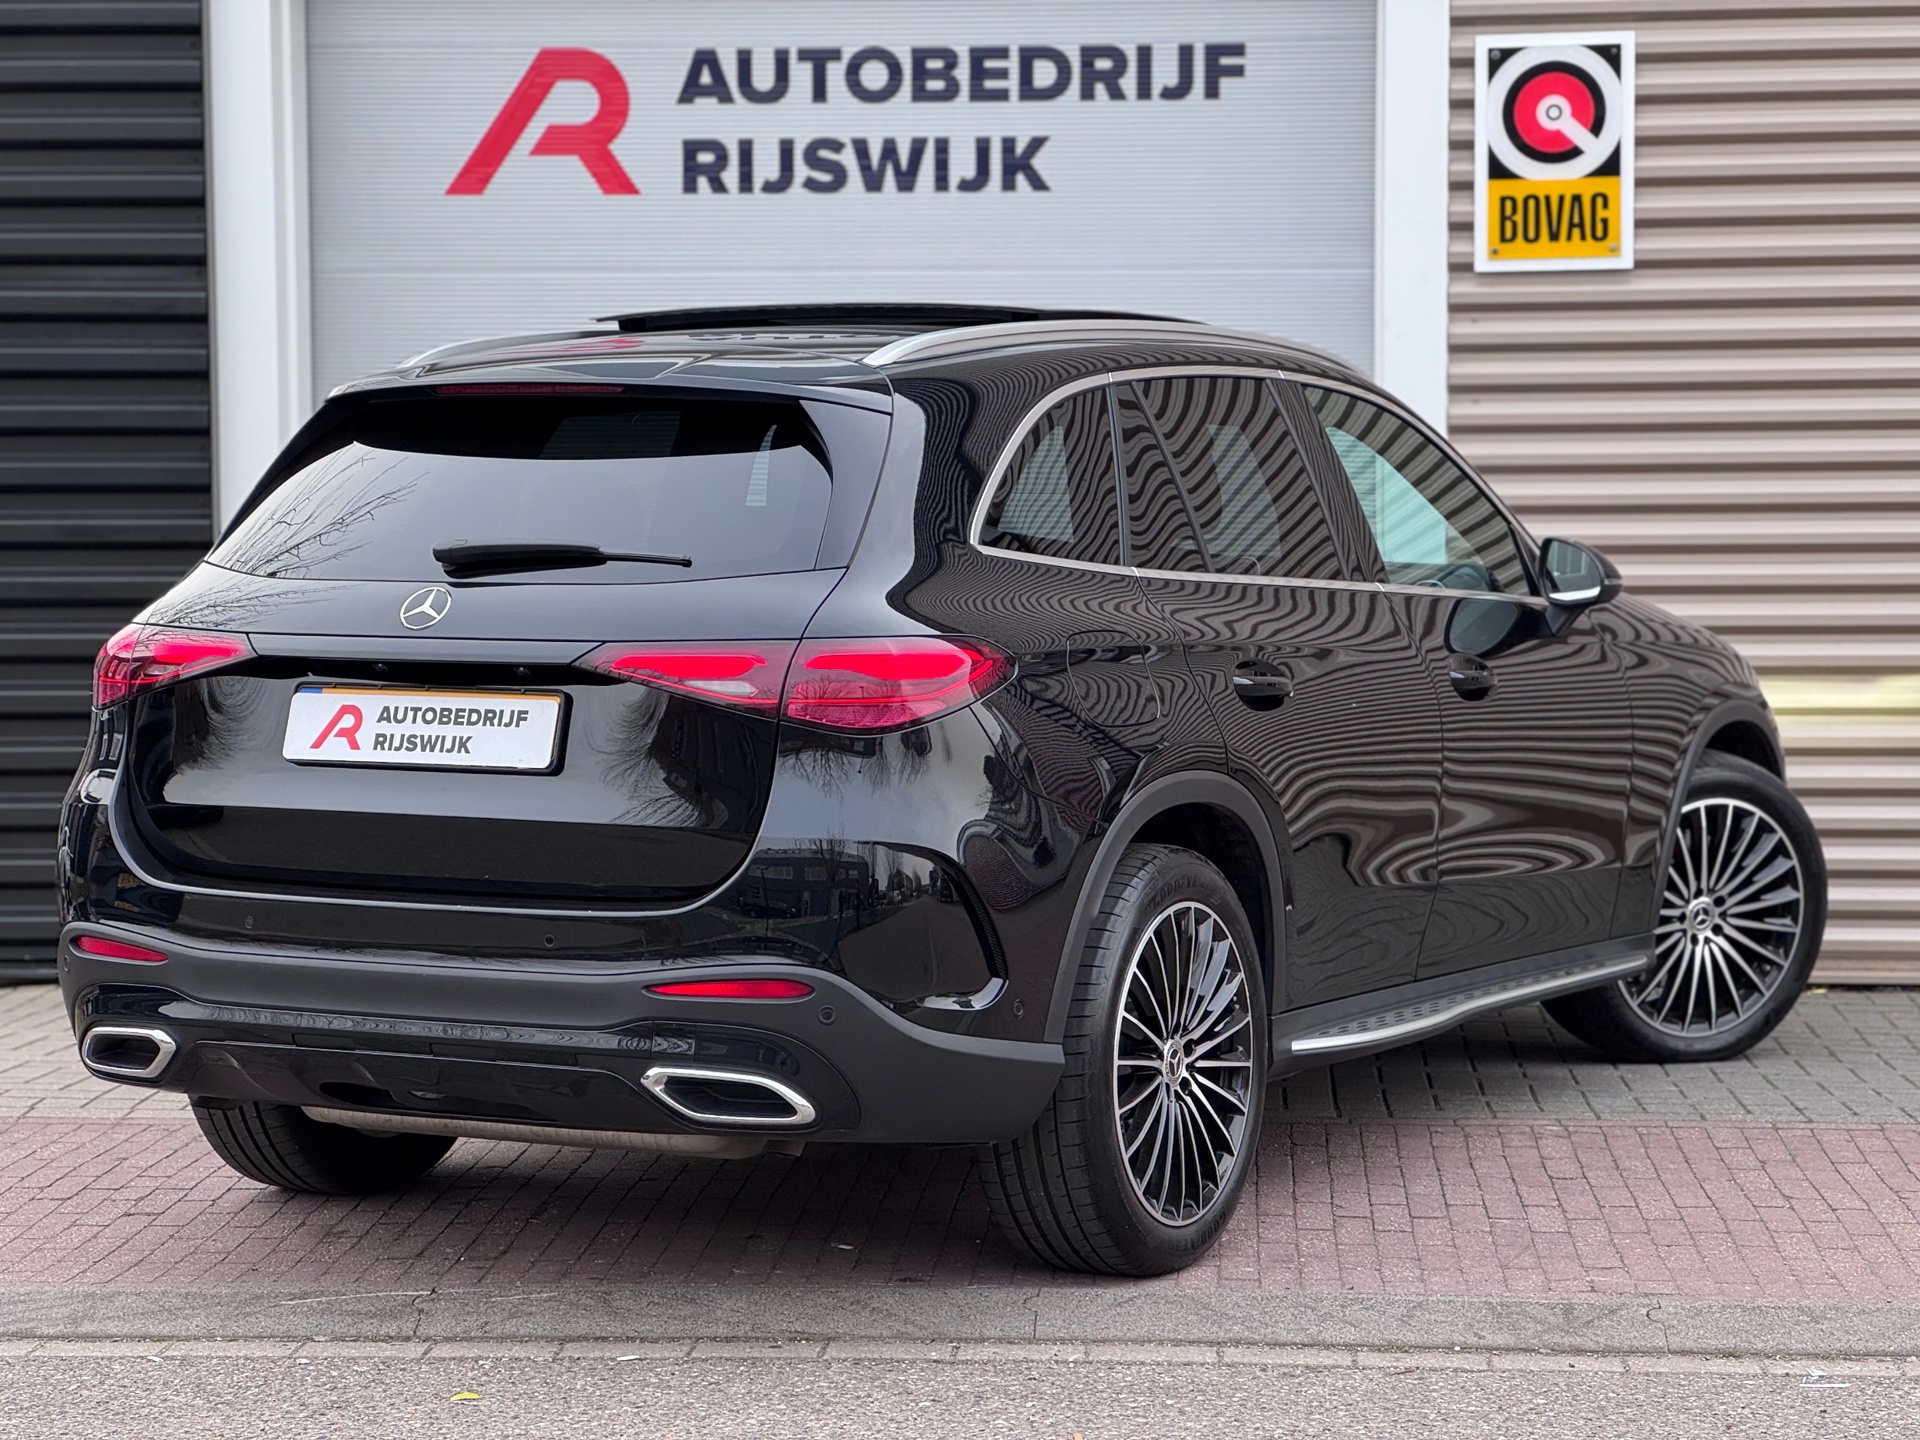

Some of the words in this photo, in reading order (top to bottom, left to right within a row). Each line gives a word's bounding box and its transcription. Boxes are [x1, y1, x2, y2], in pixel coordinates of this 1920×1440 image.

[677, 42, 1247, 105] AUTOBEDRIJF
[681, 136, 1051, 194] RIJSWIJK
[1499, 191, 1610, 244] BOVAG
[376, 705, 529, 728] AUTOBEDRIJF
[372, 733, 473, 754] RIJSWIJK
